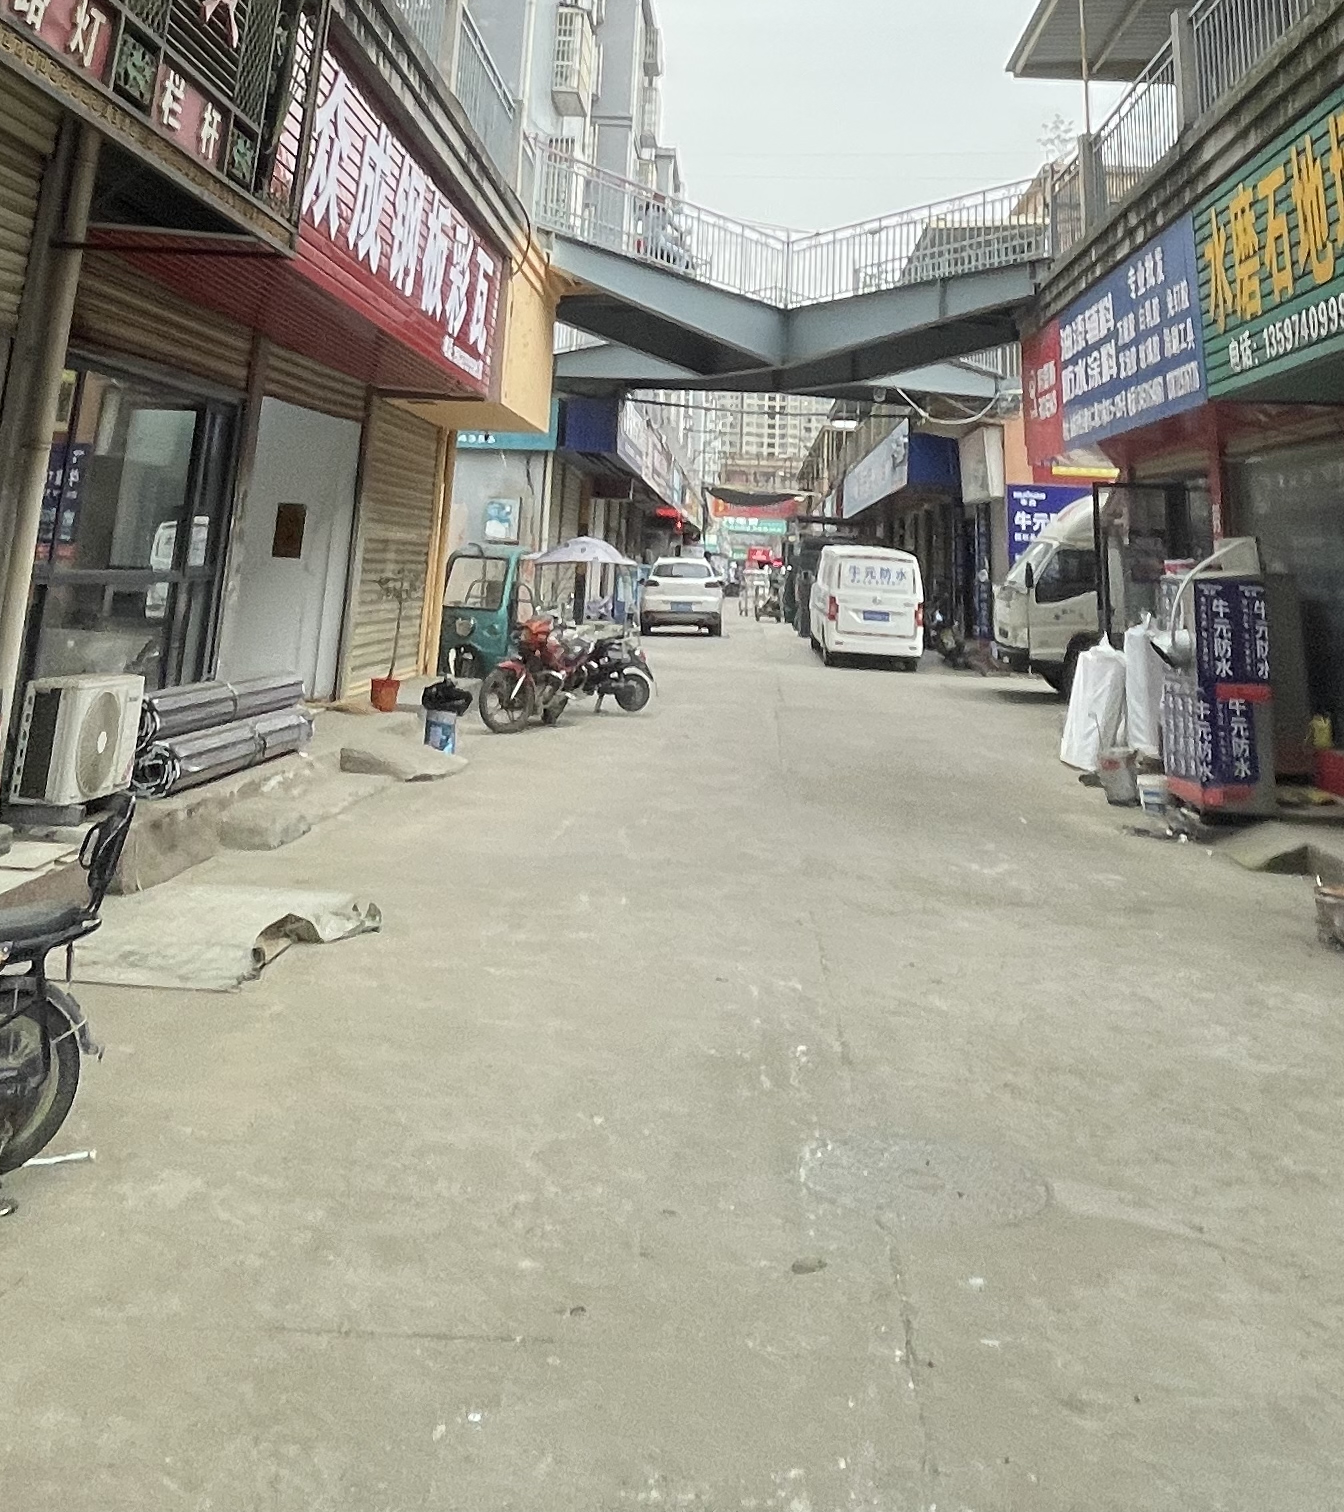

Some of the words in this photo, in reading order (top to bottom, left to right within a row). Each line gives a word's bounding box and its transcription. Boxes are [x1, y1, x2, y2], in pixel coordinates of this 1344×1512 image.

[162, 69, 222, 159] 栏杆
[1212, 598, 1233, 678] 牛元防水
[1229, 697, 1251, 779] 牛元防水
